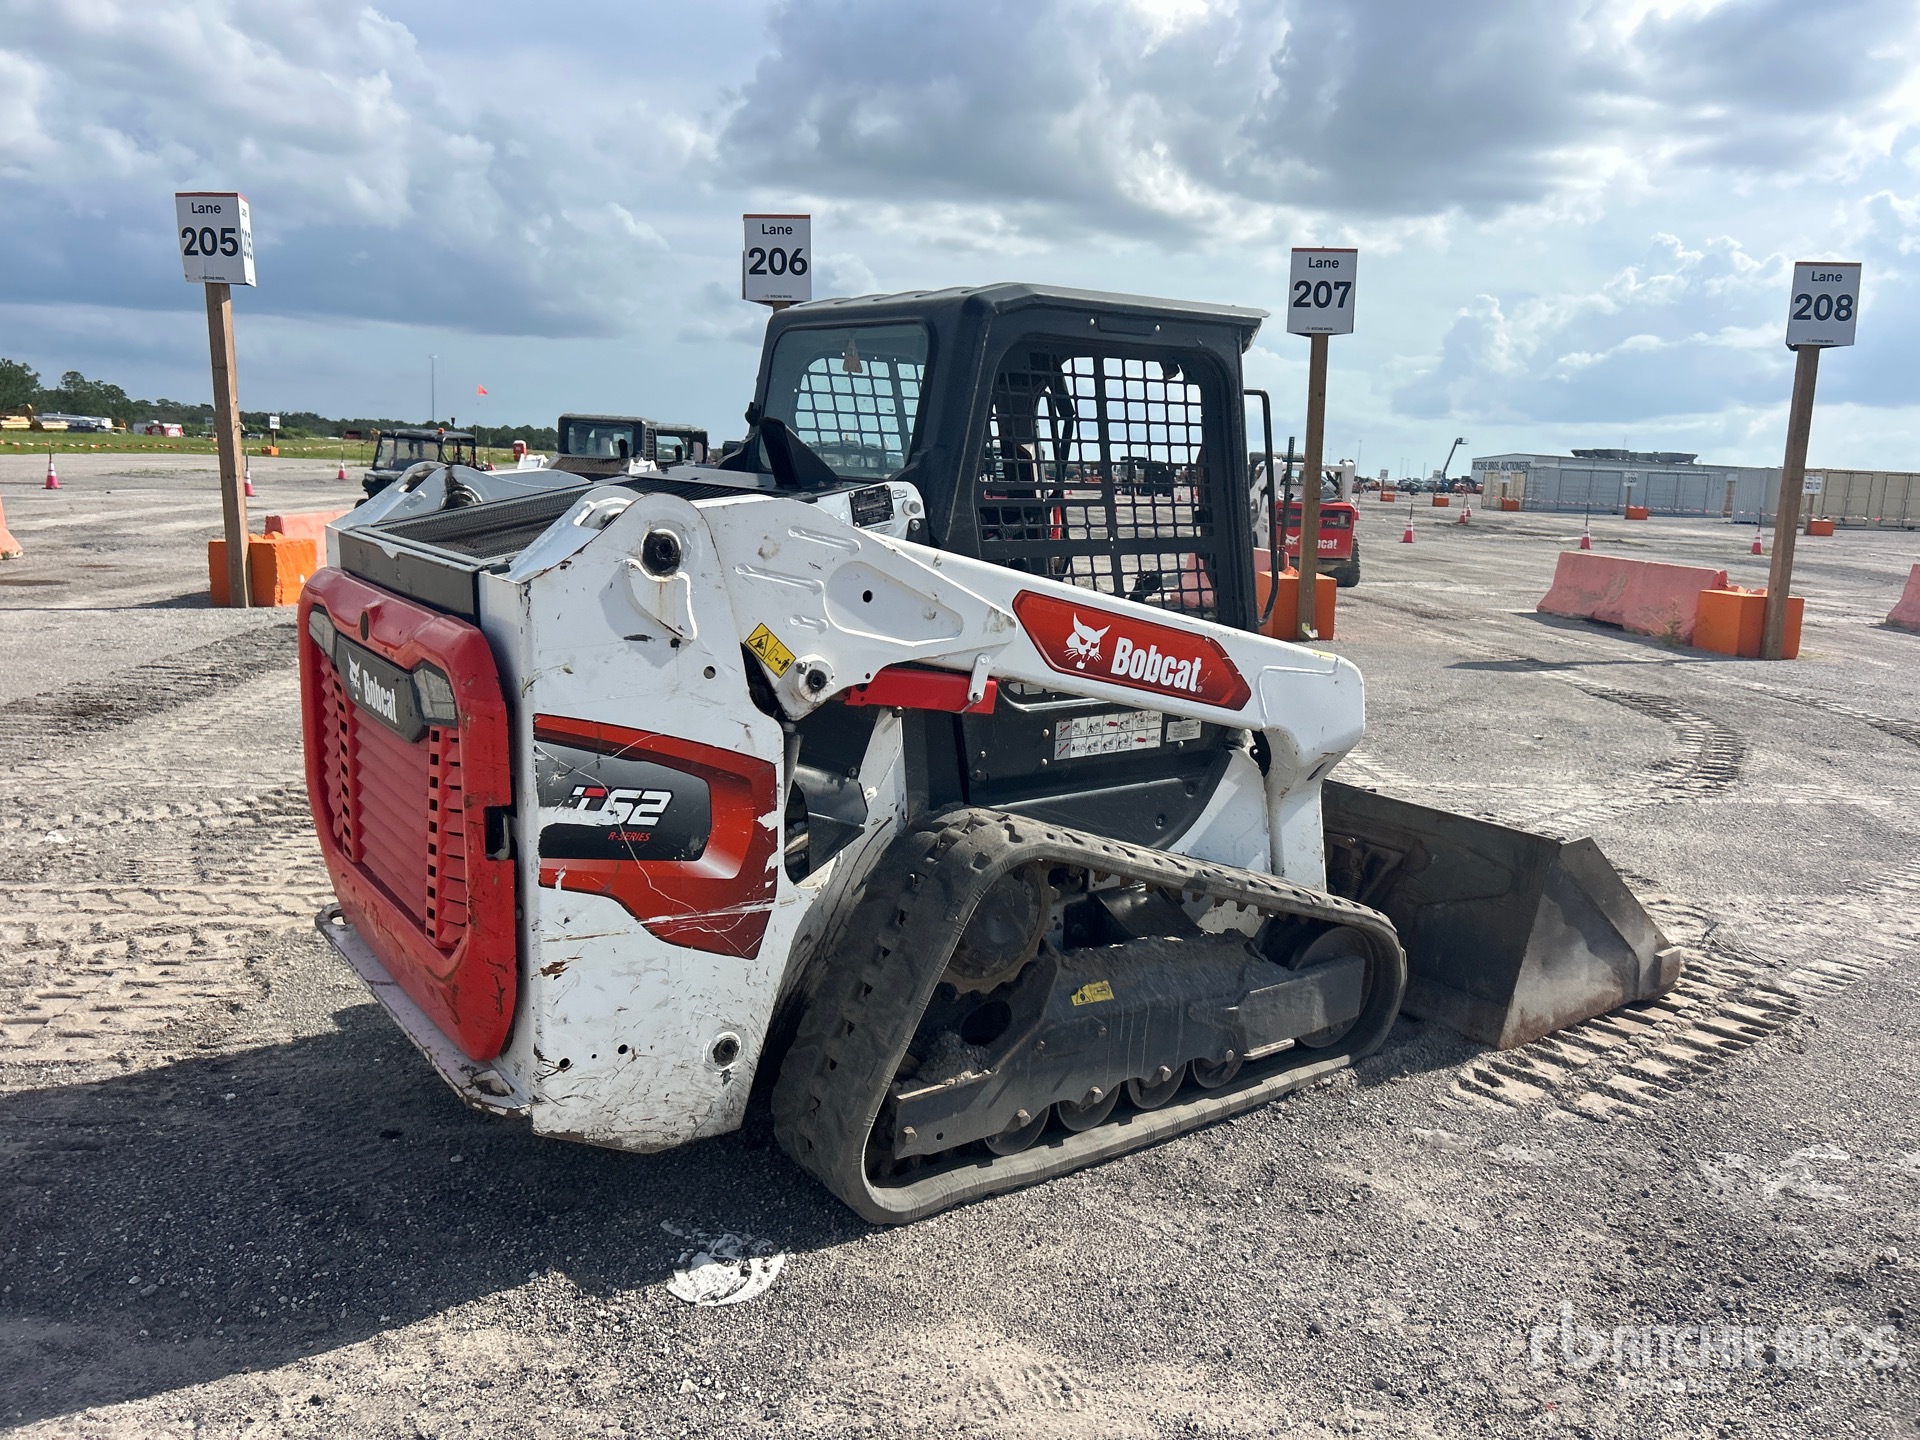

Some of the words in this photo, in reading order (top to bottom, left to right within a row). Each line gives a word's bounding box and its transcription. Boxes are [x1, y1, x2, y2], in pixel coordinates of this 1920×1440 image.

[191, 202, 222, 214] Lane
[761, 223, 793, 235] Lane
[181, 226, 239, 257] 205
[748, 247, 808, 276] 206
[1308, 256, 1340, 269] Lane
[1811, 270, 1843, 282] Lane
[1292, 280, 1352, 309] 207
[1792, 293, 1854, 322] 208
[1317, 538, 1338, 550] cat
[1110, 636, 1203, 692] Bobcat
[362, 669, 398, 724] Bobcat
[607, 831, 651, 842] R-SERIES
